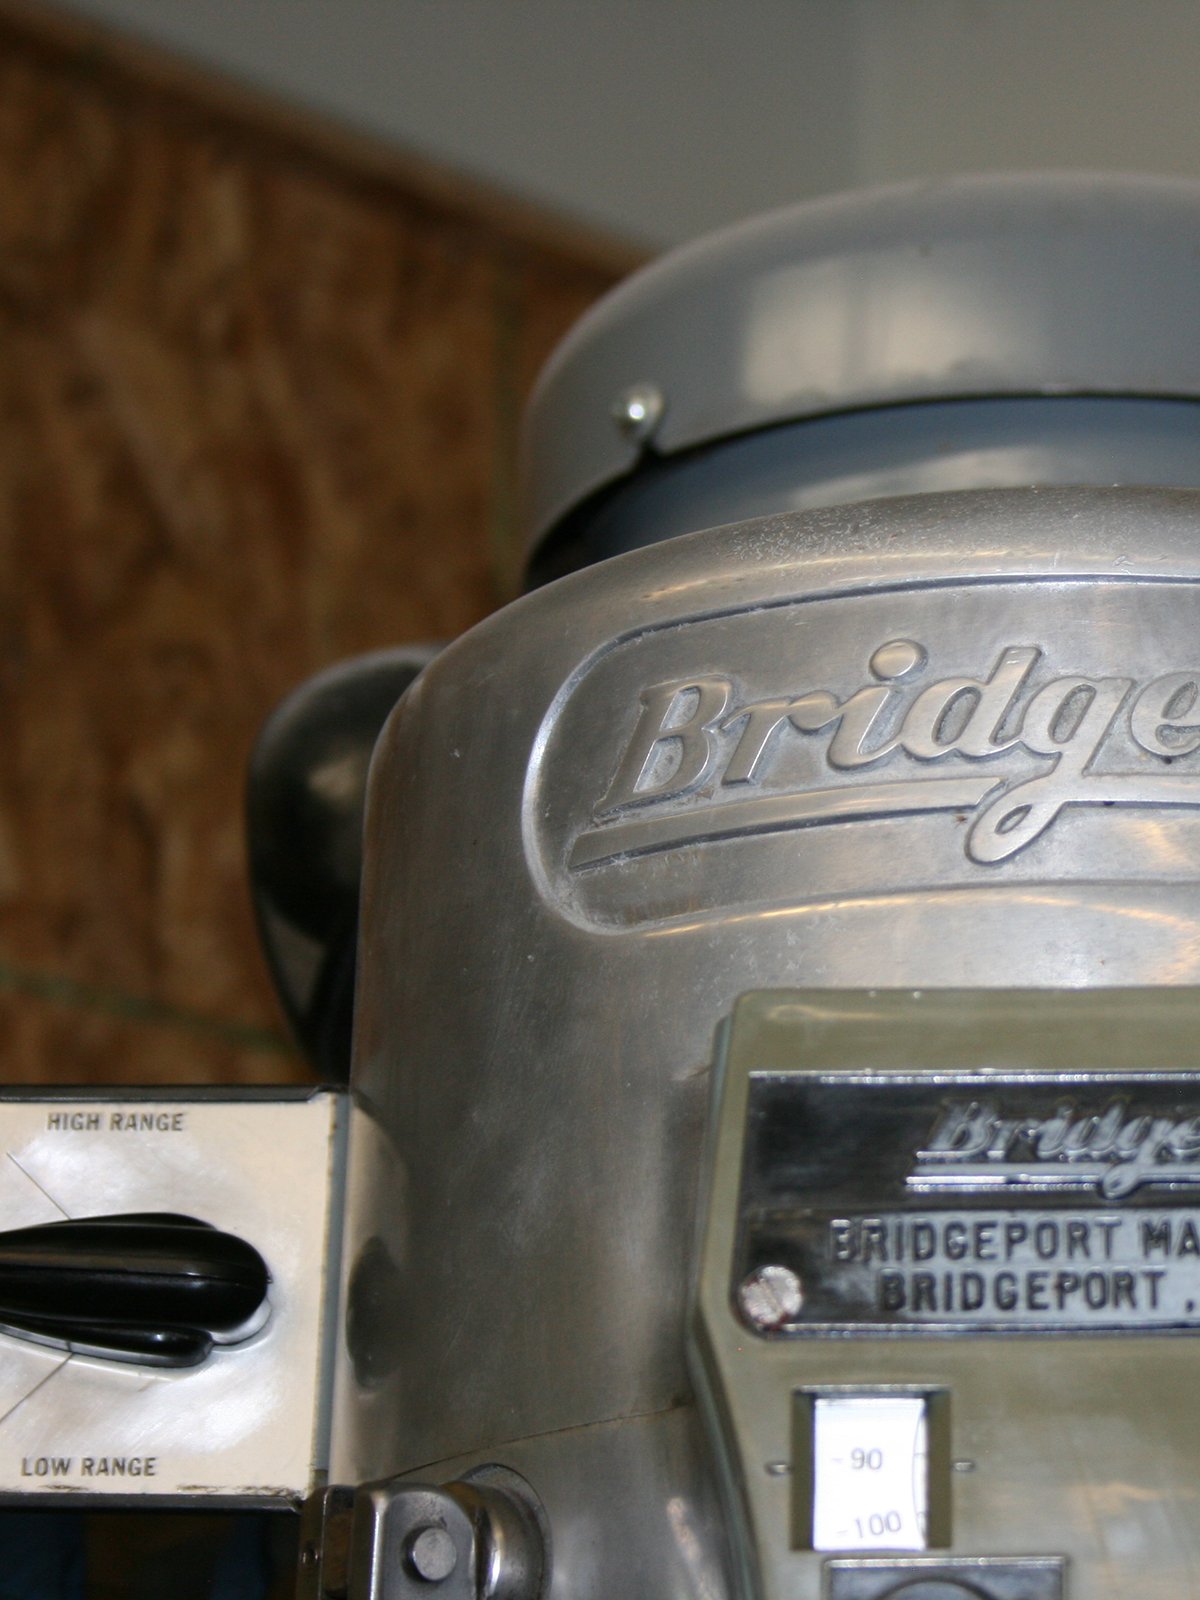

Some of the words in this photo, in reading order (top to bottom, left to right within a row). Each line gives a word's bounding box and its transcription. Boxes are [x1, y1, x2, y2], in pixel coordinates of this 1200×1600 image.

[47, 1112, 101, 1131] HIGH
[109, 1112, 186, 1132] RANGE
[830, 1216, 1122, 1262] BRIDGEPORT
[21, 1457, 71, 1477] LOW
[81, 1457, 157, 1477] RANGE
